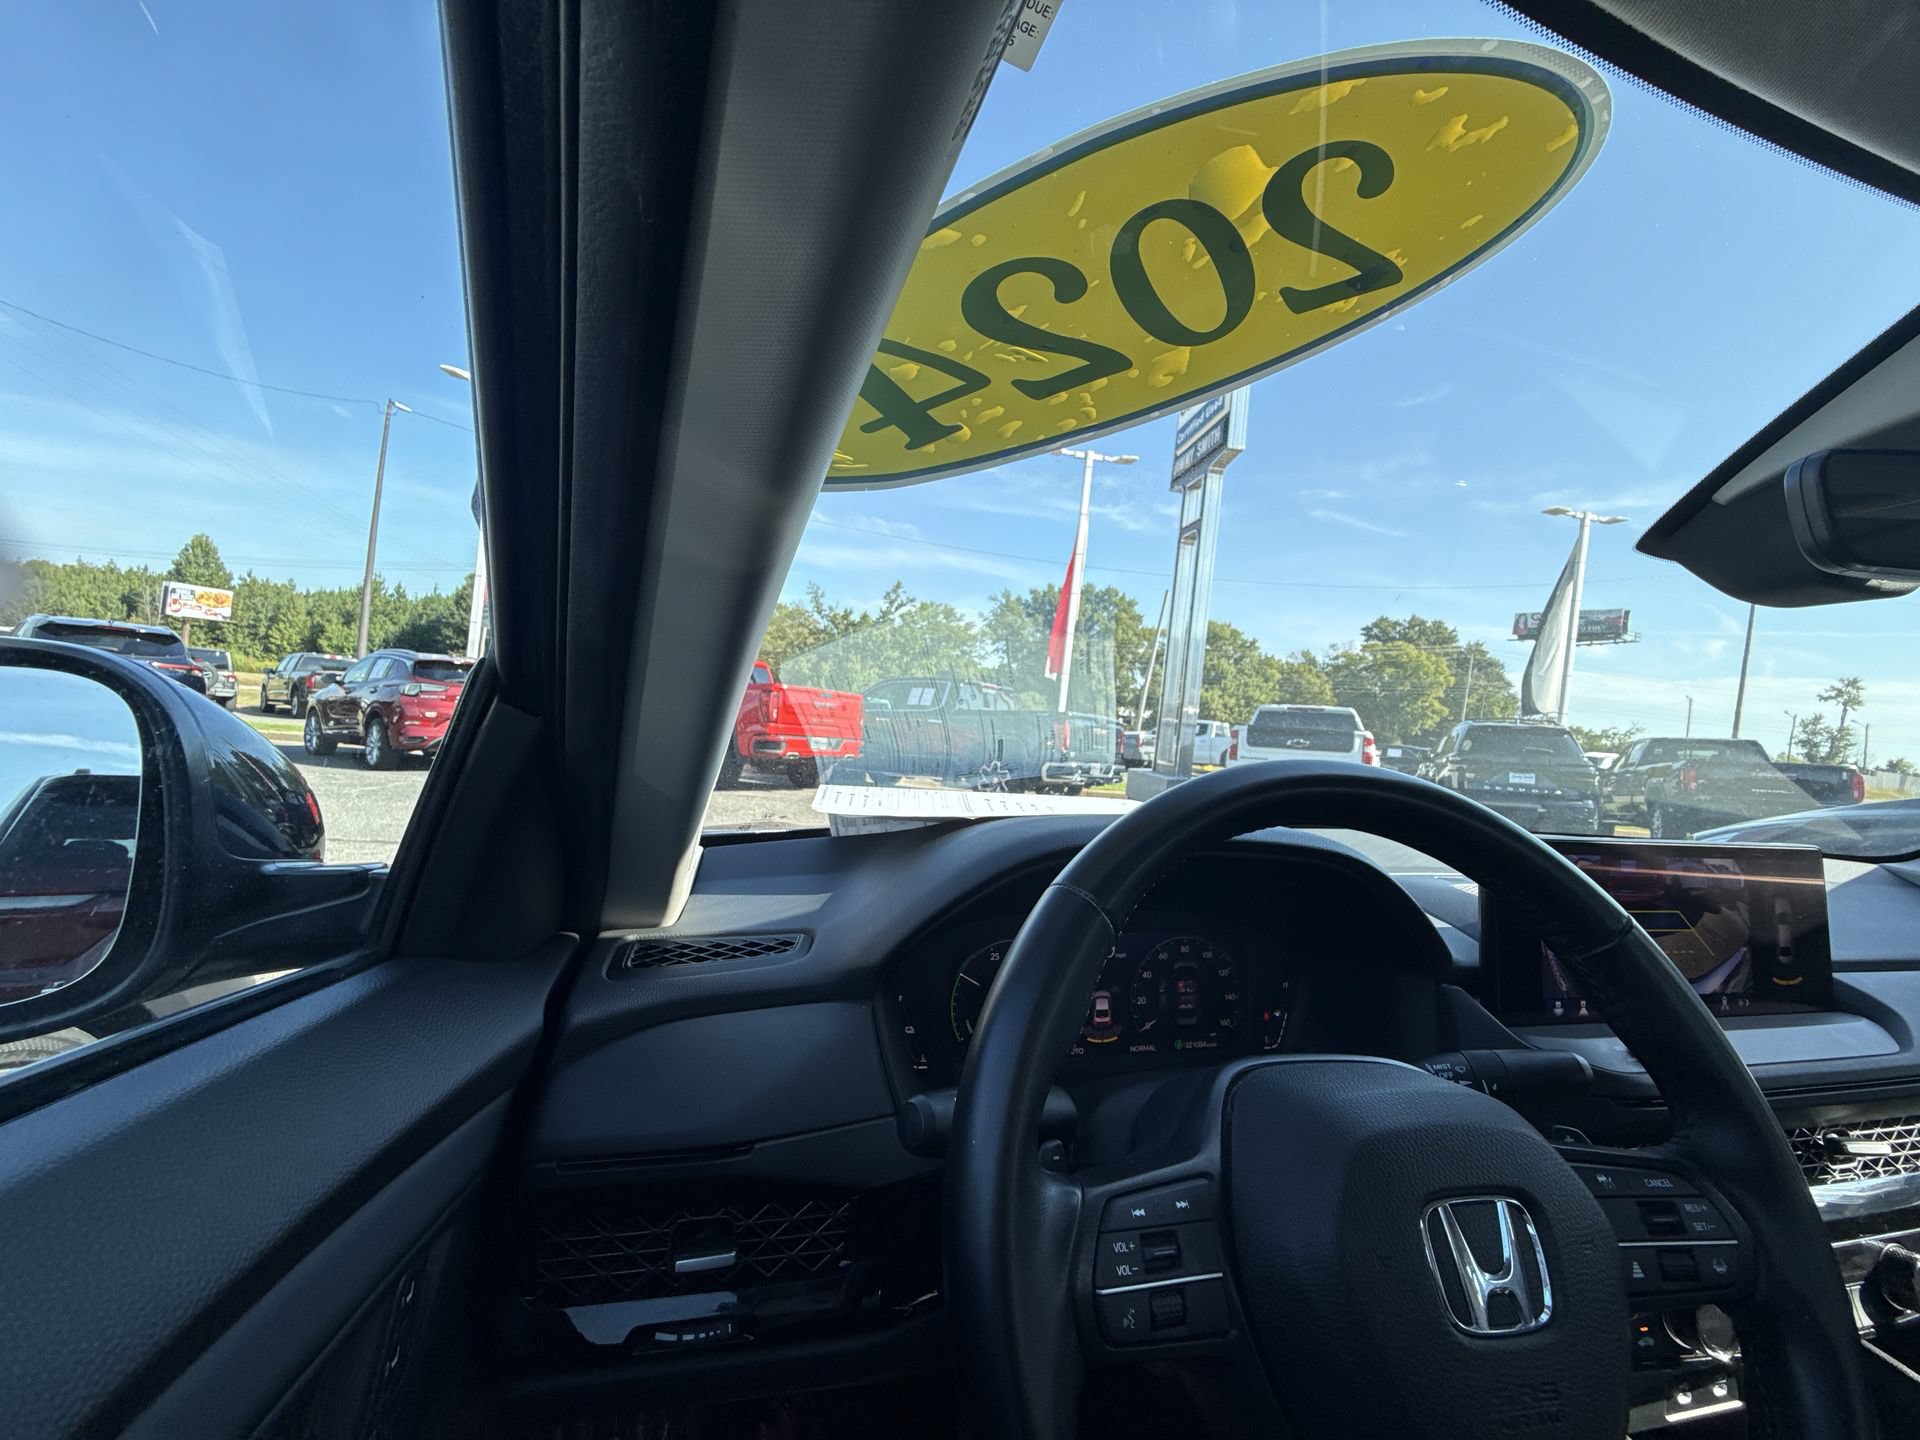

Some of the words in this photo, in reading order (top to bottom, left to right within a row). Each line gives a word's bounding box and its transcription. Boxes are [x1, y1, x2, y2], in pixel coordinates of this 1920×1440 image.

[1197, 424, 1221, 457] SMITH
[989, 952, 1000, 961] 25
[1142, 970, 1152, 979] 40
[1129, 1044, 1157, 1053] NORMAL
[1643, 1178, 1675, 1187] CANCEL
[1112, 1241, 1136, 1253] VOL+
